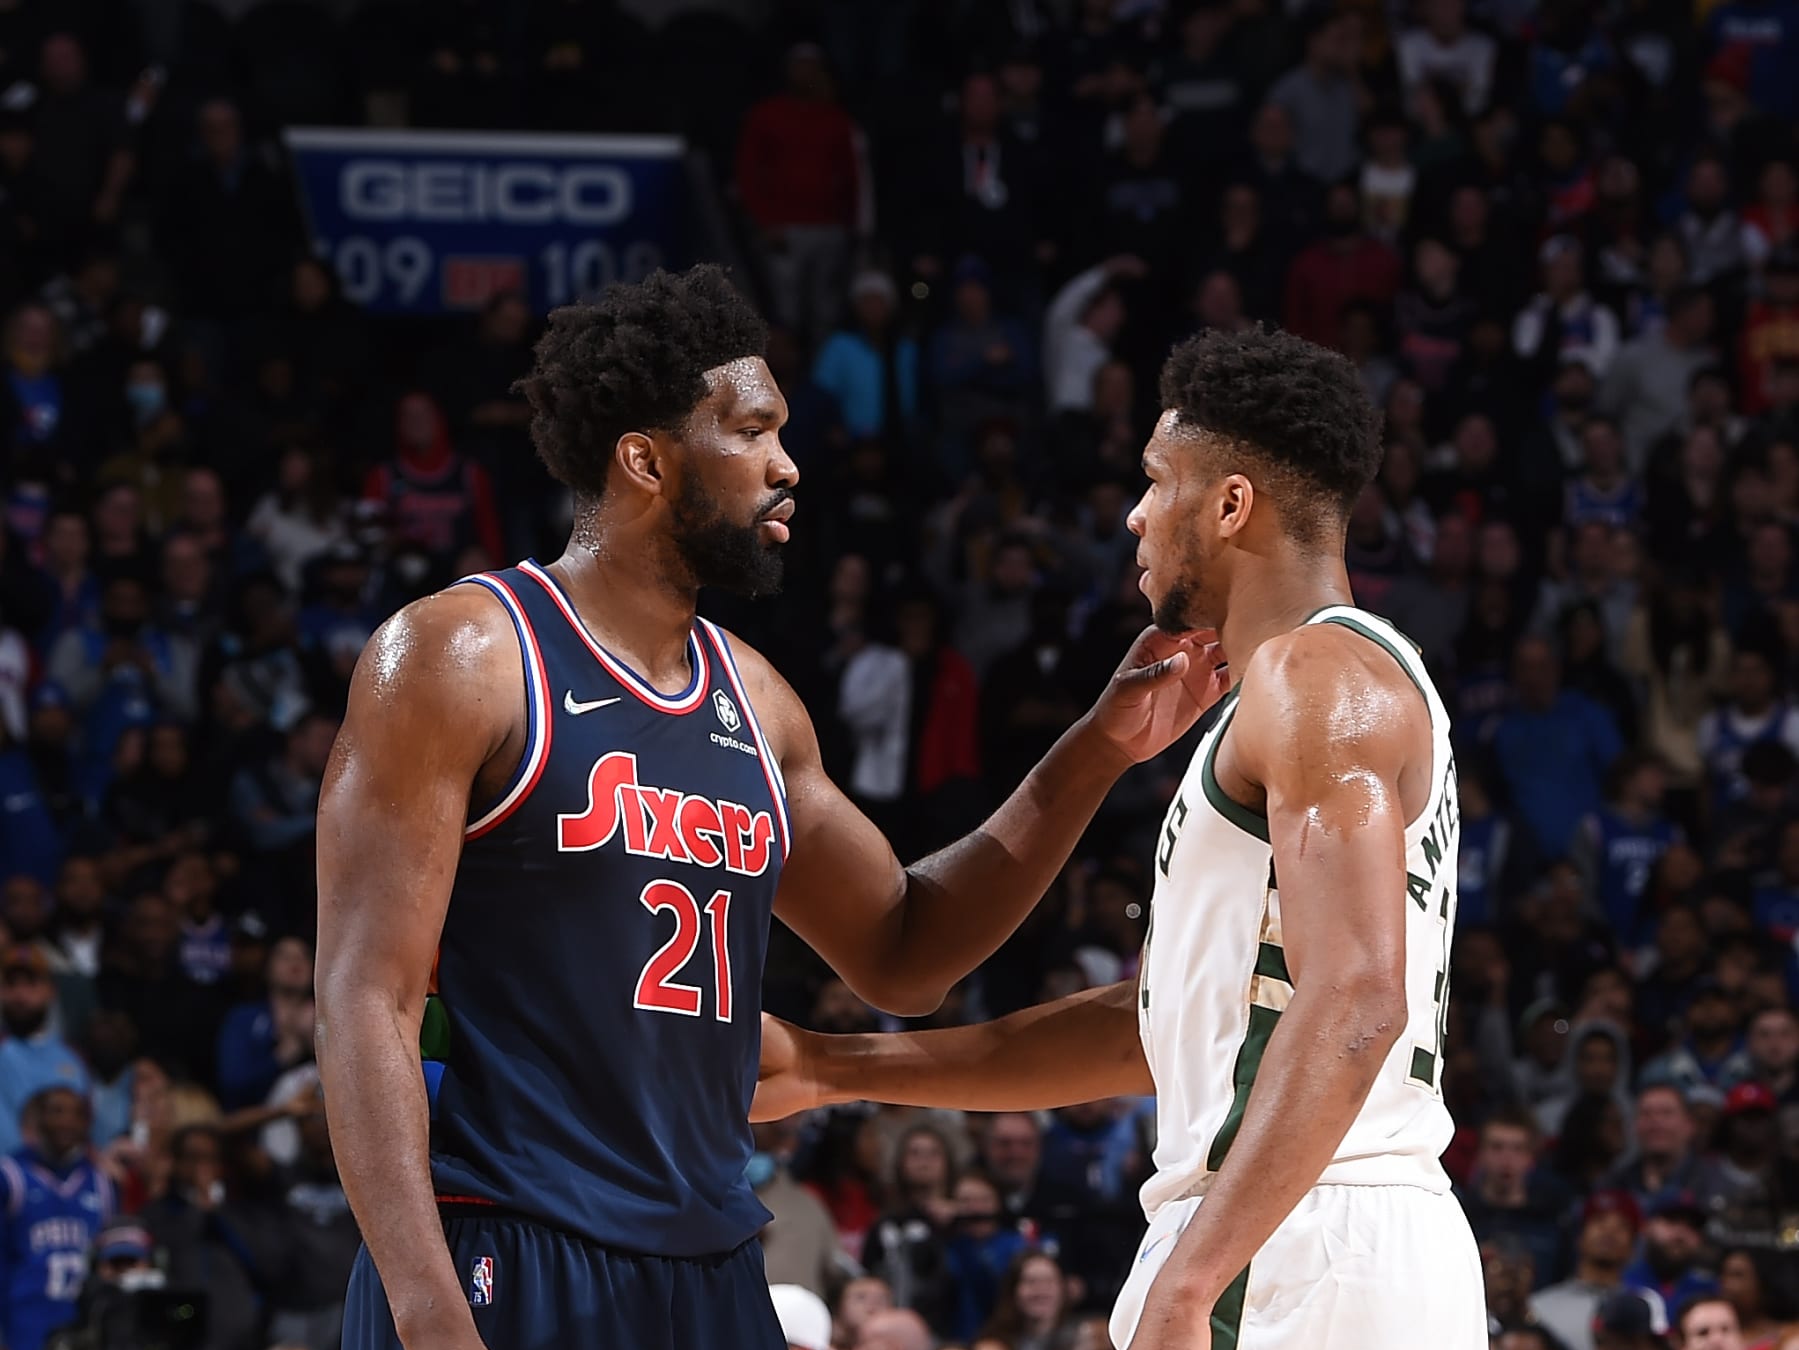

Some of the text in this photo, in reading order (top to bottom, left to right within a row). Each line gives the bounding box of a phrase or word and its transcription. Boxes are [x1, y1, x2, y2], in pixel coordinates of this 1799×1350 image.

[340, 160, 634, 225] GEICO
[312, 236, 433, 306] 09
[710, 733, 758, 757] crypto.com
[557, 751, 776, 877] Sixers
[634, 879, 733, 1023] 21
